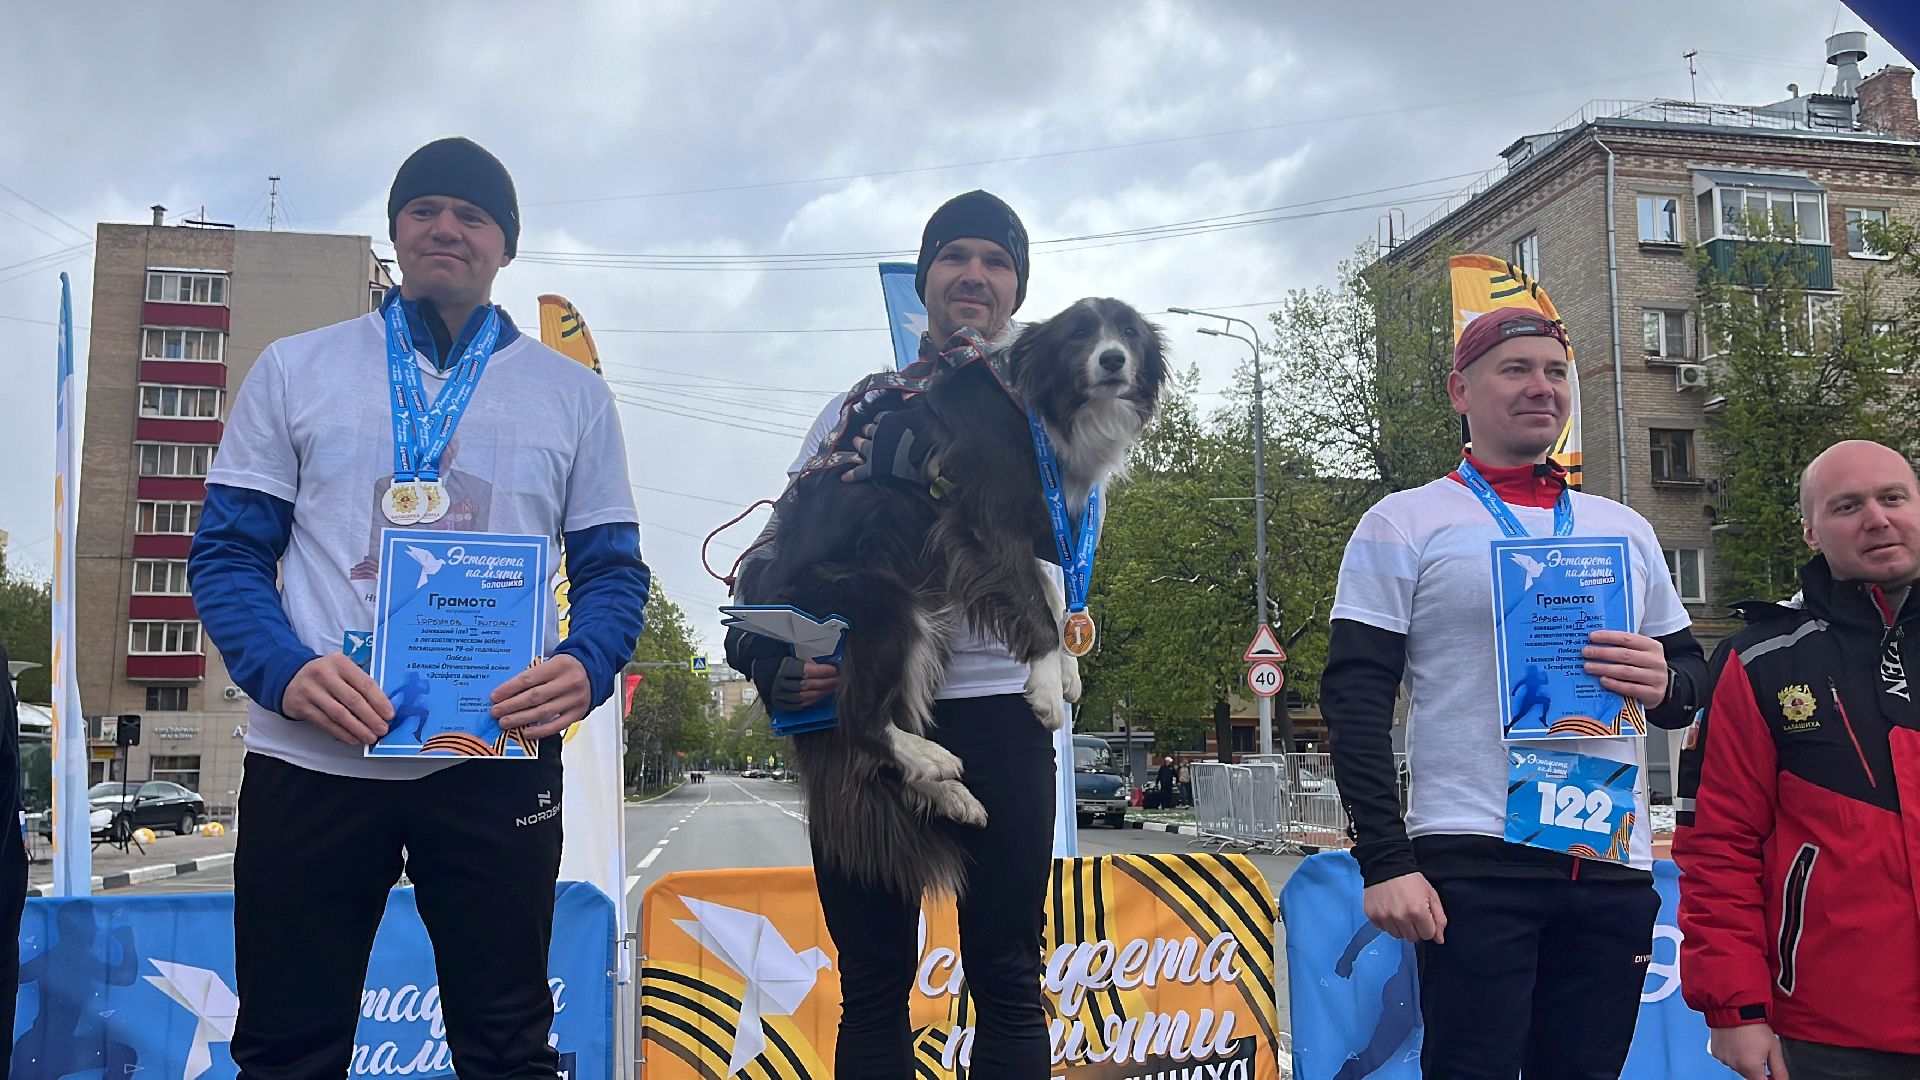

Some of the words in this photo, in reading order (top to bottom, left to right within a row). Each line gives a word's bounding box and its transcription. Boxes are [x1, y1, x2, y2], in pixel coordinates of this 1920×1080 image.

[446, 546, 524, 569] Эстафета
[1546, 549, 1613, 569] Эстафета
[466, 567, 523, 580] памяти
[1565, 567, 1613, 578] памяти
[481, 578, 523, 589] Балашиха
[1580, 576, 1615, 587] Балашиха
[428, 593, 496, 609] Грамота
[1536, 593, 1595, 608] Грамота
[1074, 626, 1082, 645] 1
[1255, 672, 1276, 686] 40
[1537, 781, 1613, 834] 122
